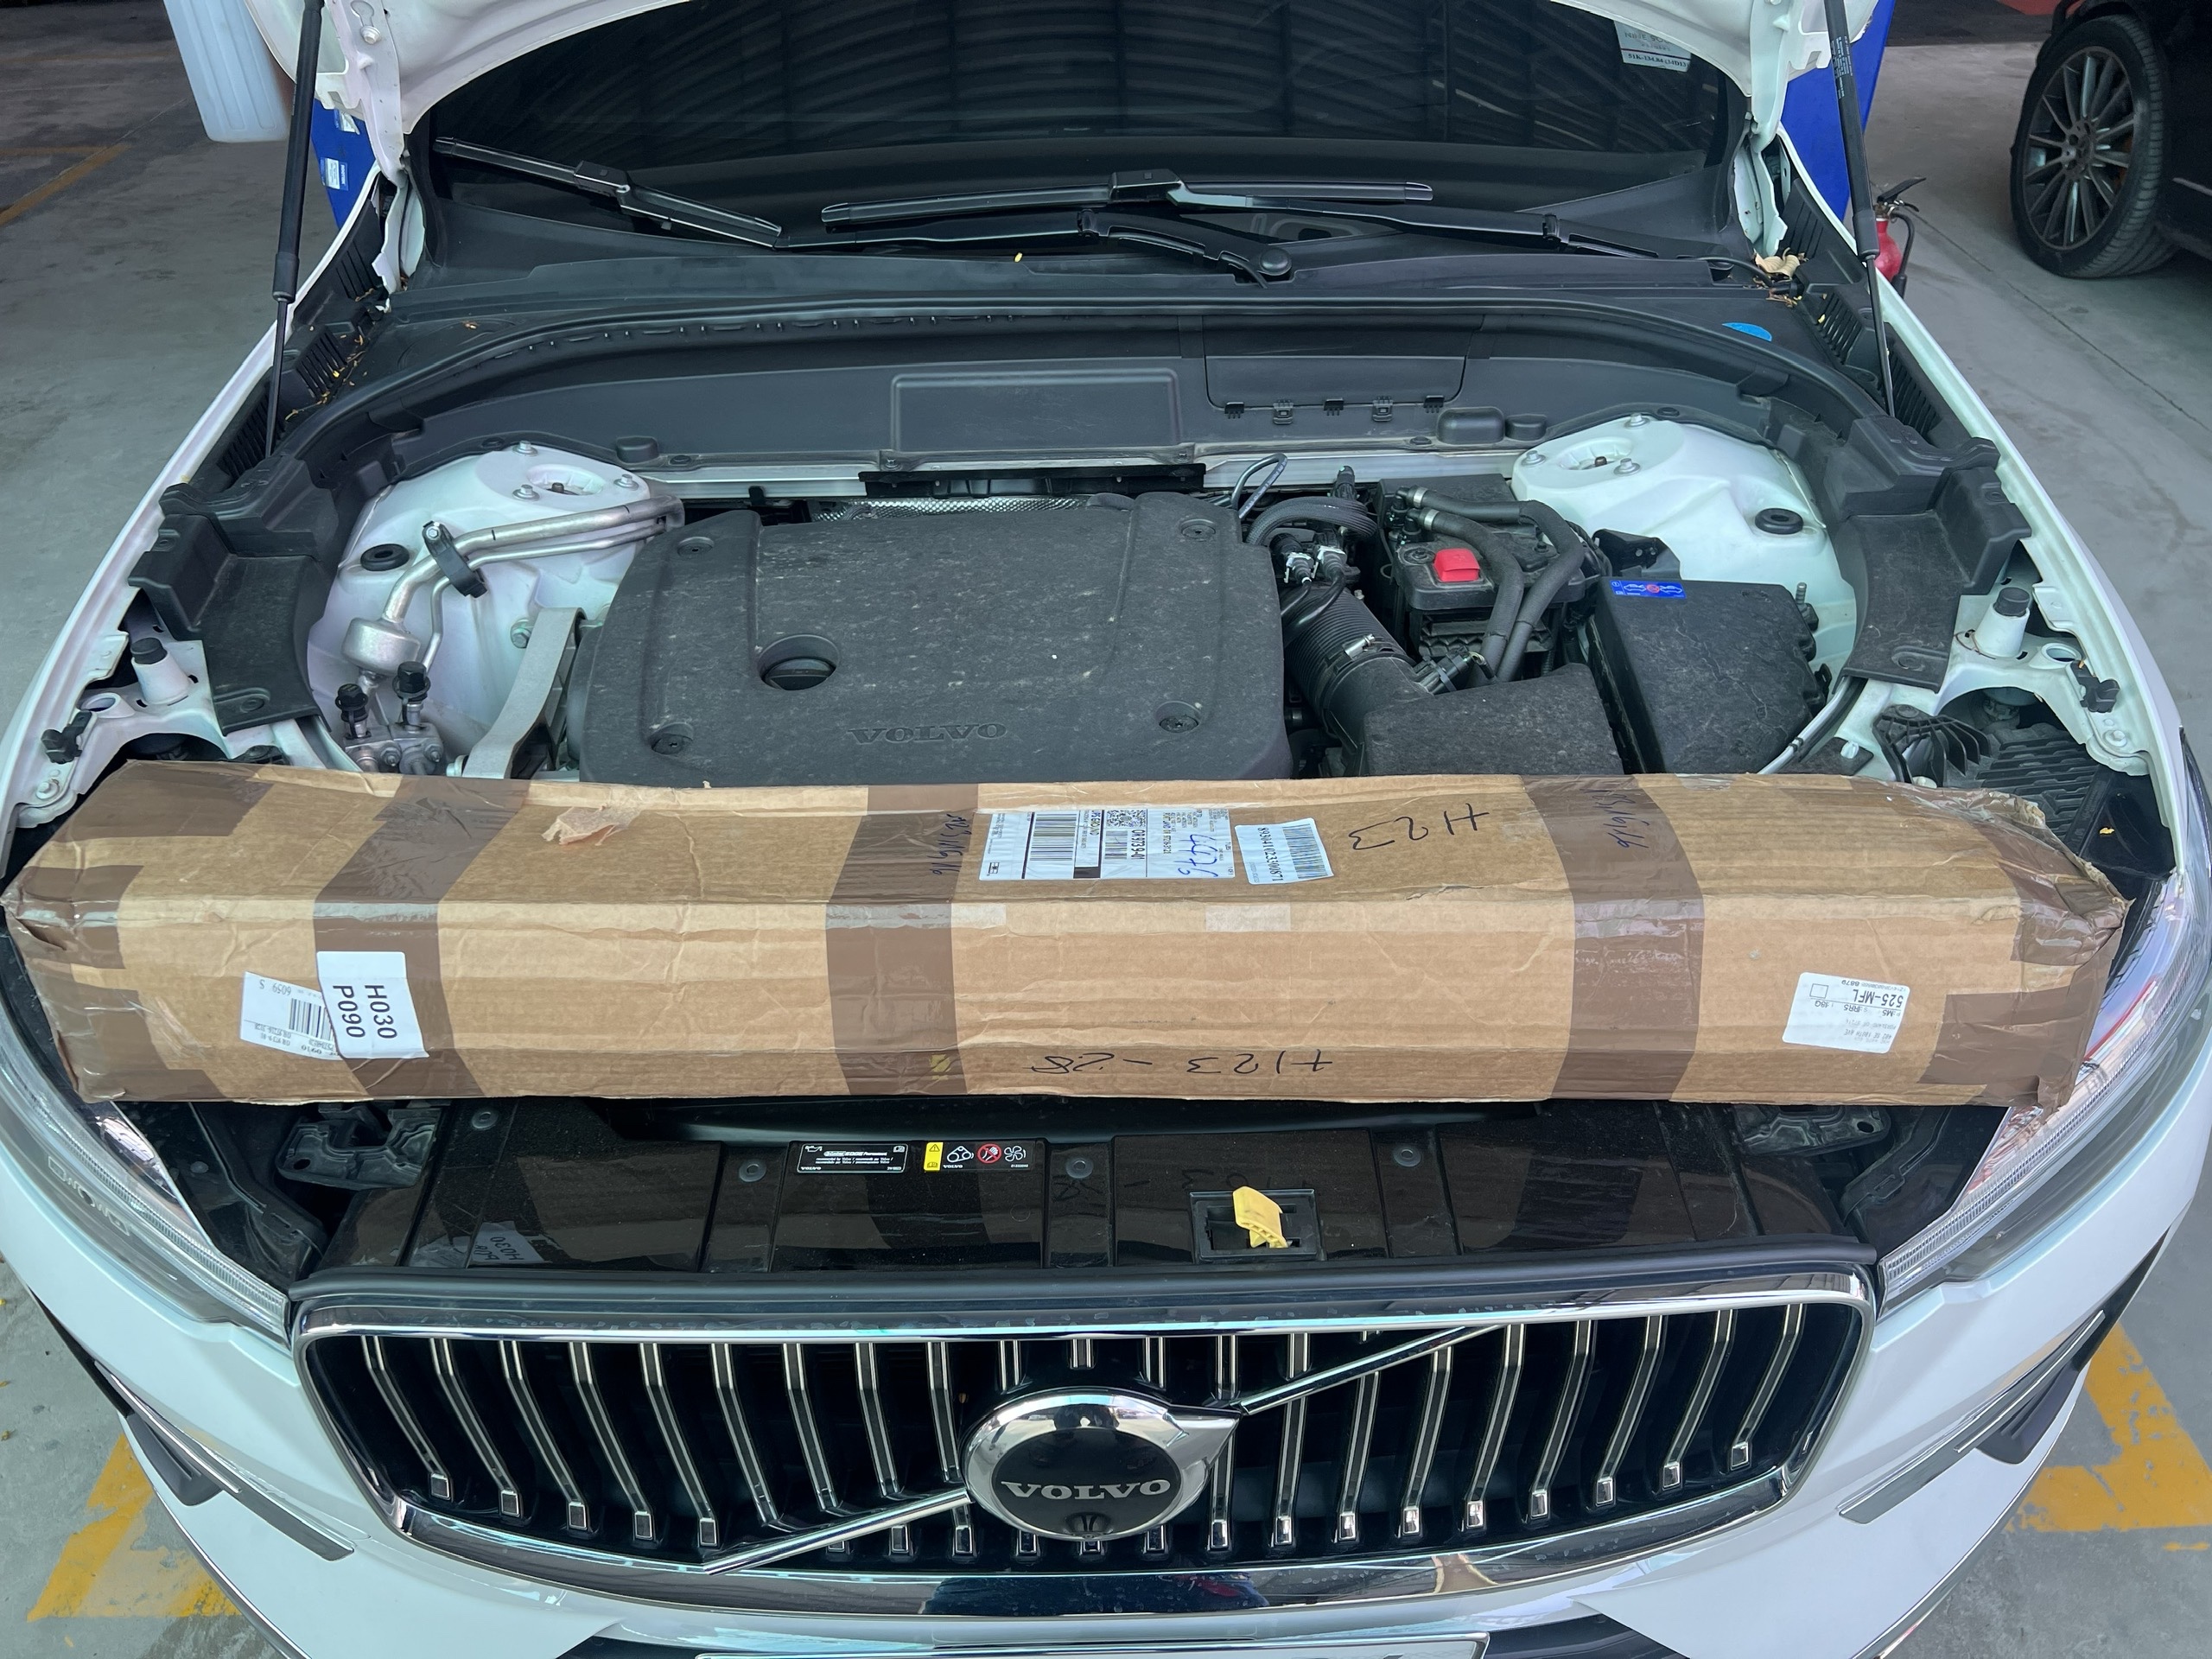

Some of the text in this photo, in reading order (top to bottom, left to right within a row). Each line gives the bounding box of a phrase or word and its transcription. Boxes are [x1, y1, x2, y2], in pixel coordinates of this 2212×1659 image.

[846, 724, 1007, 745] VOLVO
[1853, 988, 1904, 1008] 525-MFL
[332, 985, 366, 1039] P090
[364, 985, 398, 1039] H030
[1001, 1479, 1171, 1500] VOLVO
